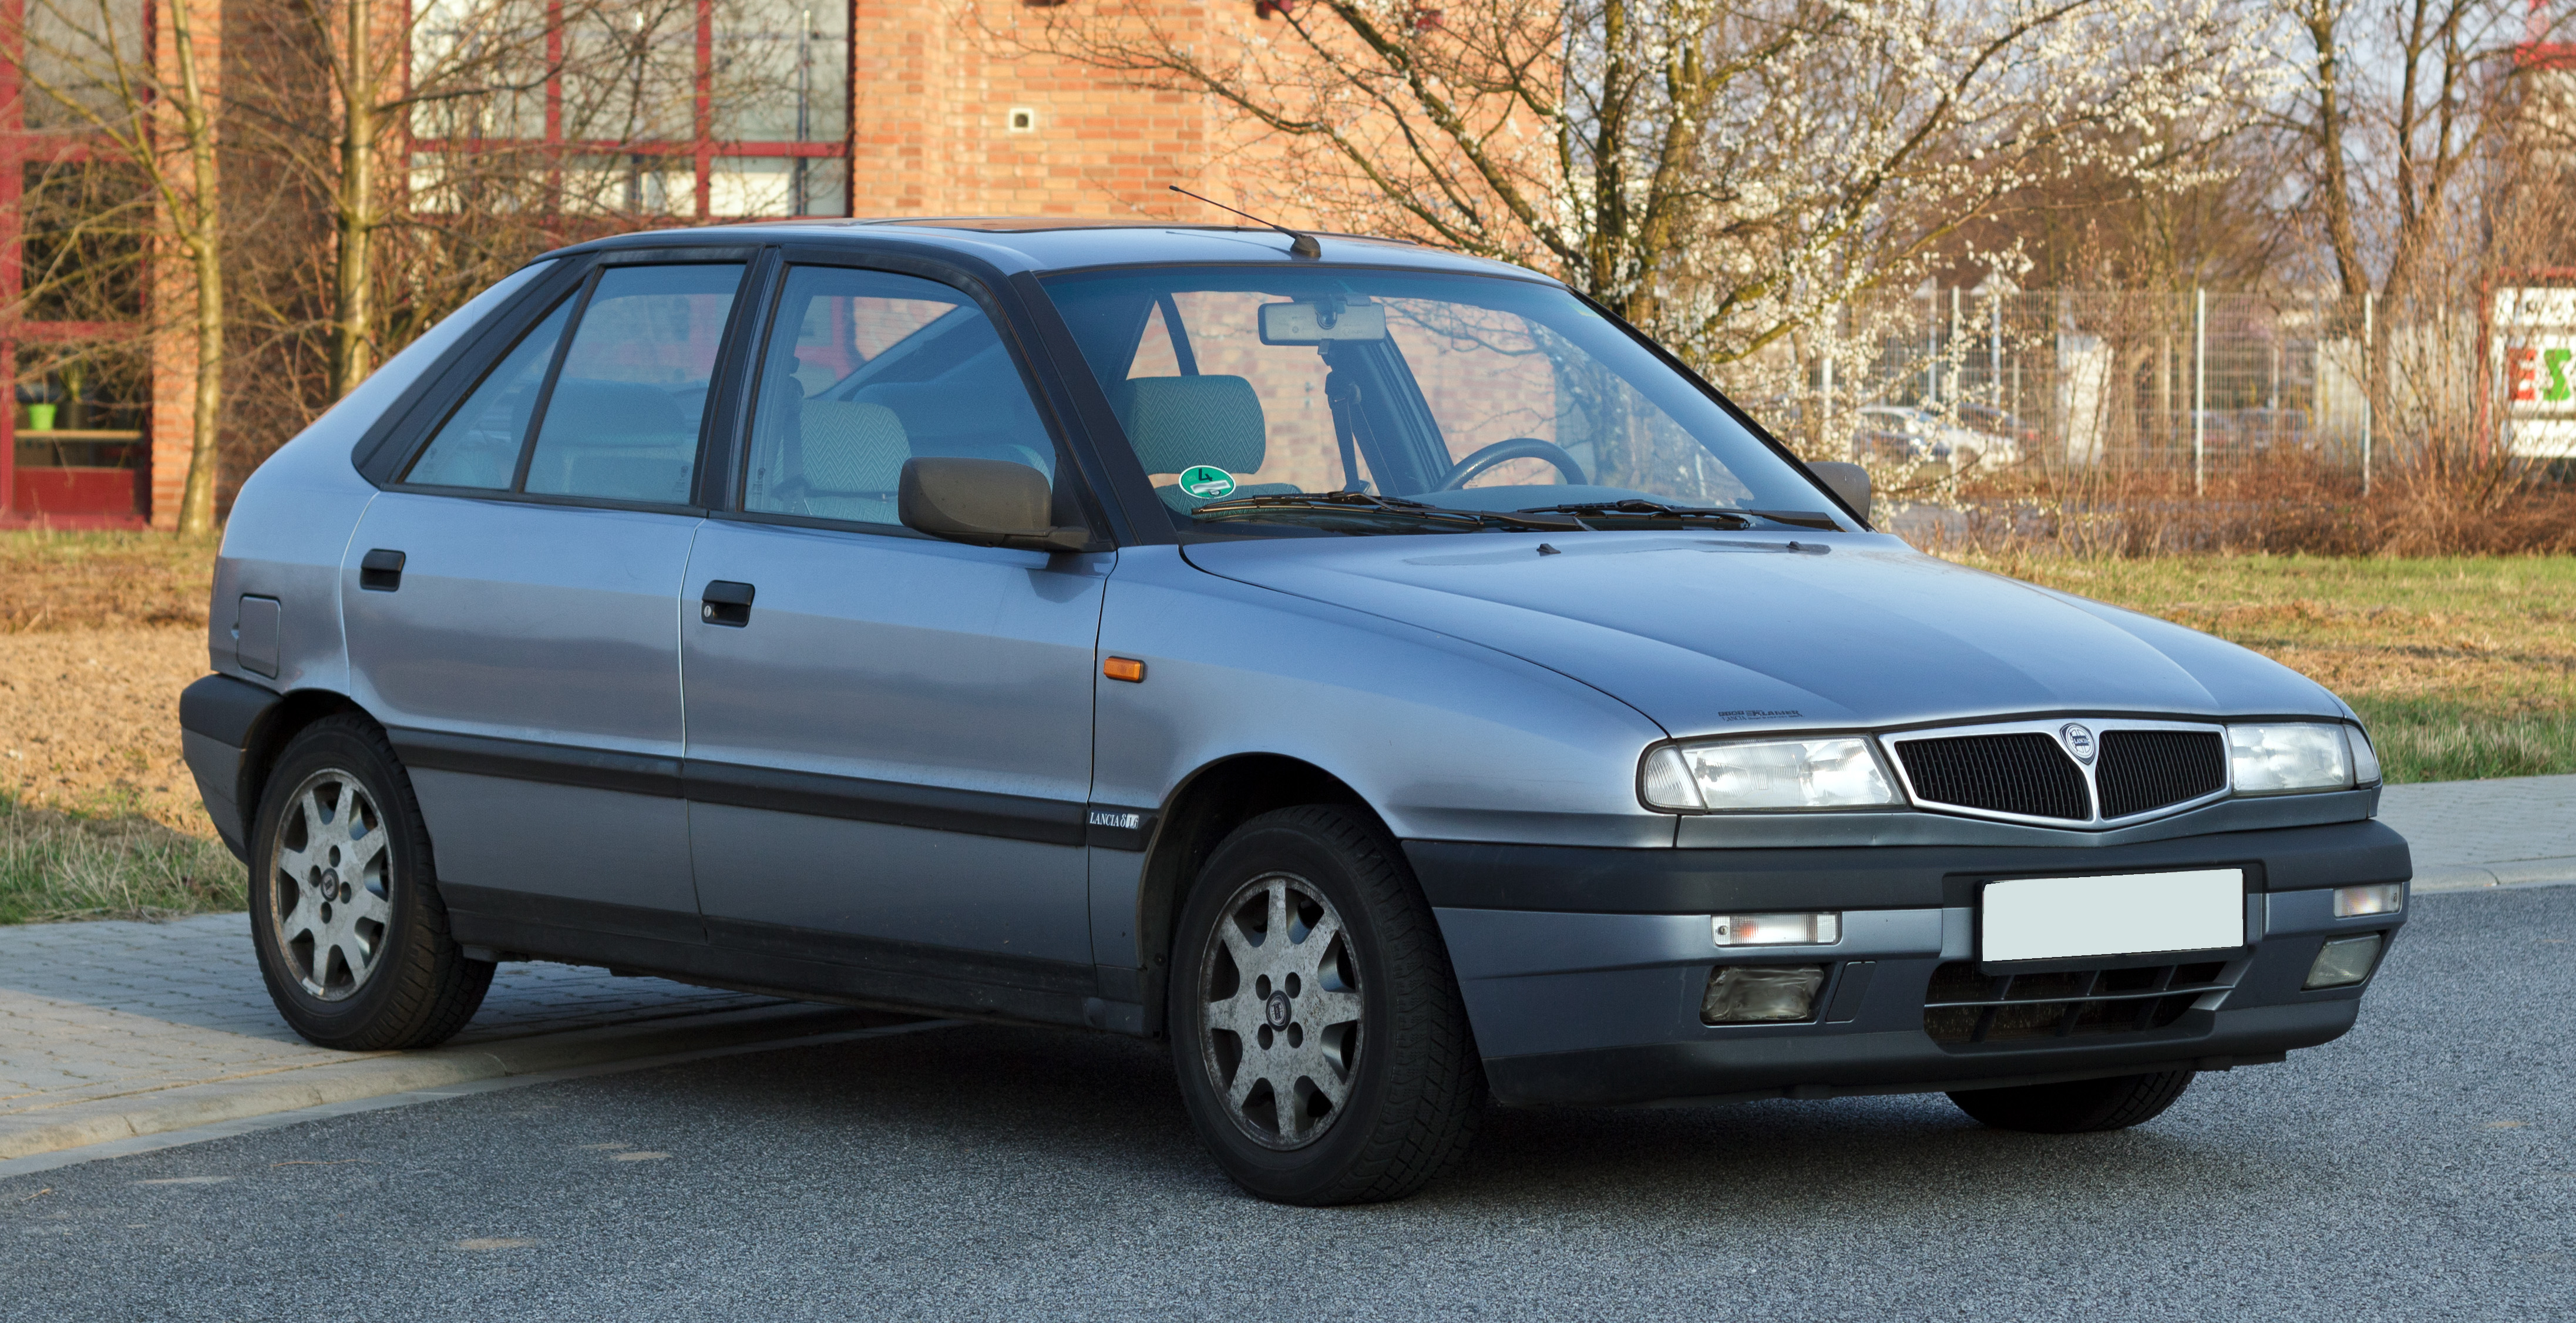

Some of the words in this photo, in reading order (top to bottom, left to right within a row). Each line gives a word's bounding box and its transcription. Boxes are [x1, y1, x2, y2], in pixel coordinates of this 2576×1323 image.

[1199, 468, 1212, 481] 4
[1089, 812, 1119, 827] LANCIA
[1128, 816, 1139, 829] 1.6
